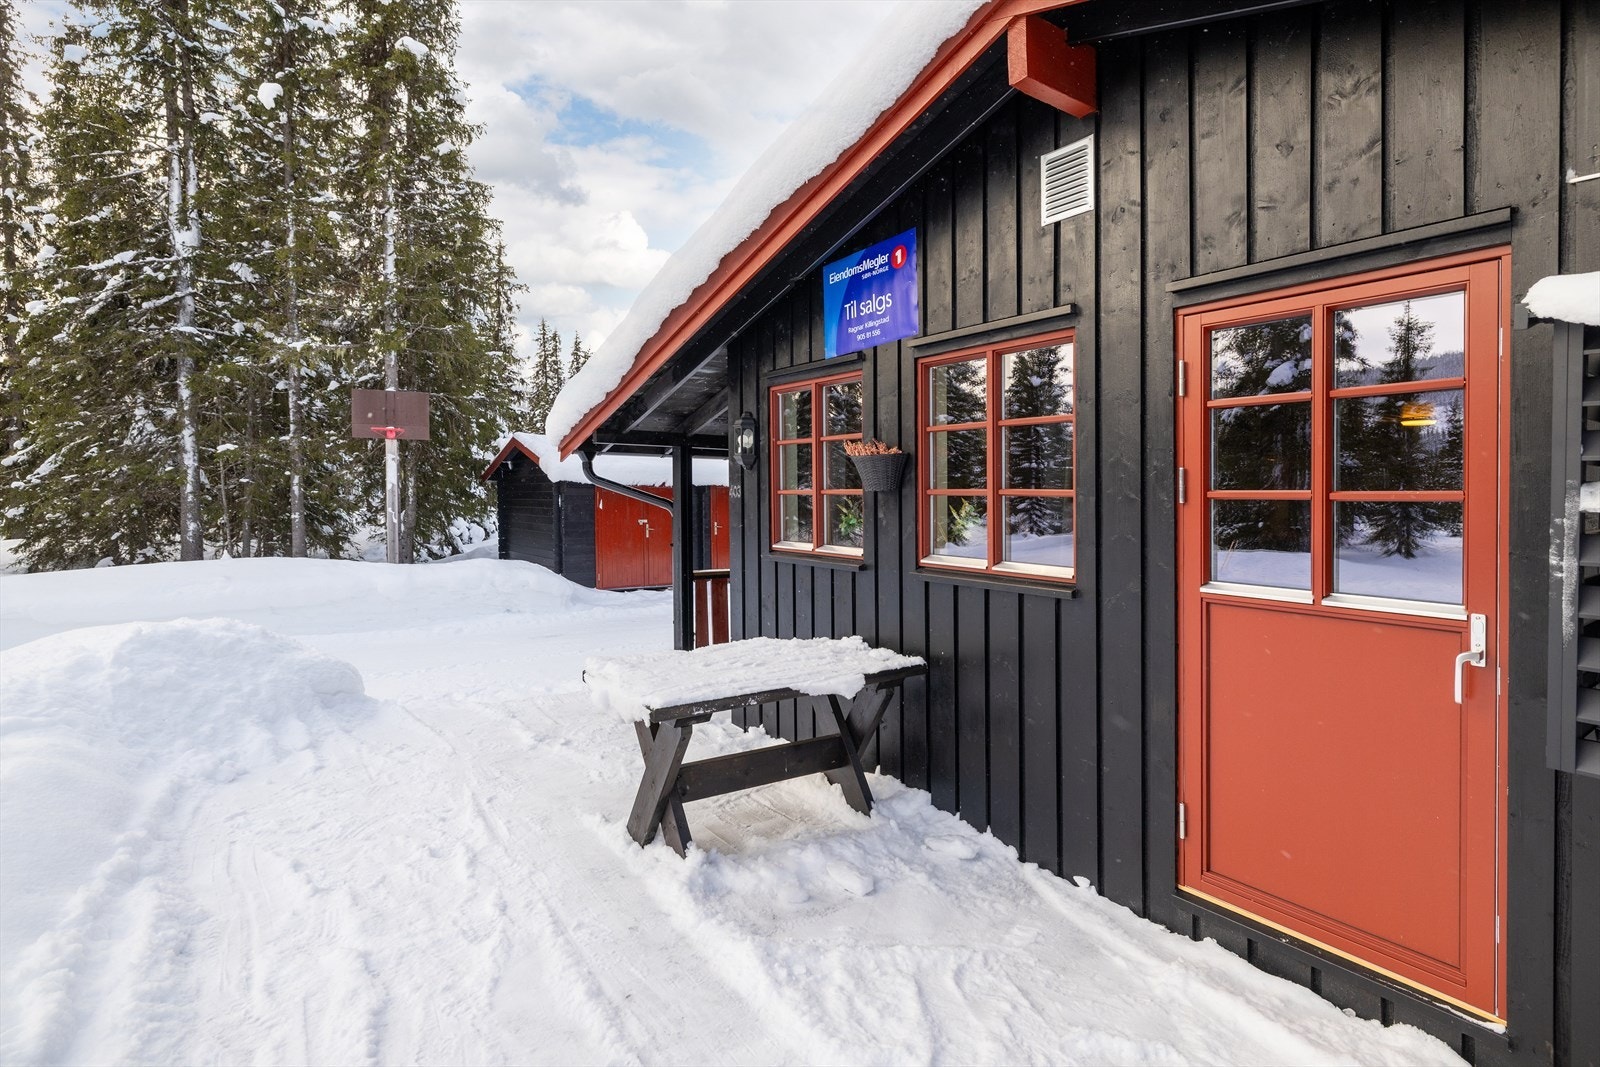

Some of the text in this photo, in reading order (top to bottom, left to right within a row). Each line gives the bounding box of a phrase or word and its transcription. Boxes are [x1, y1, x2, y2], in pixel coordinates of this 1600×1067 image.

[829, 248, 902, 285] EiendomsMegler 1
[844, 293, 892, 320] Til salgs
[848, 324, 864, 334] Ragnar
